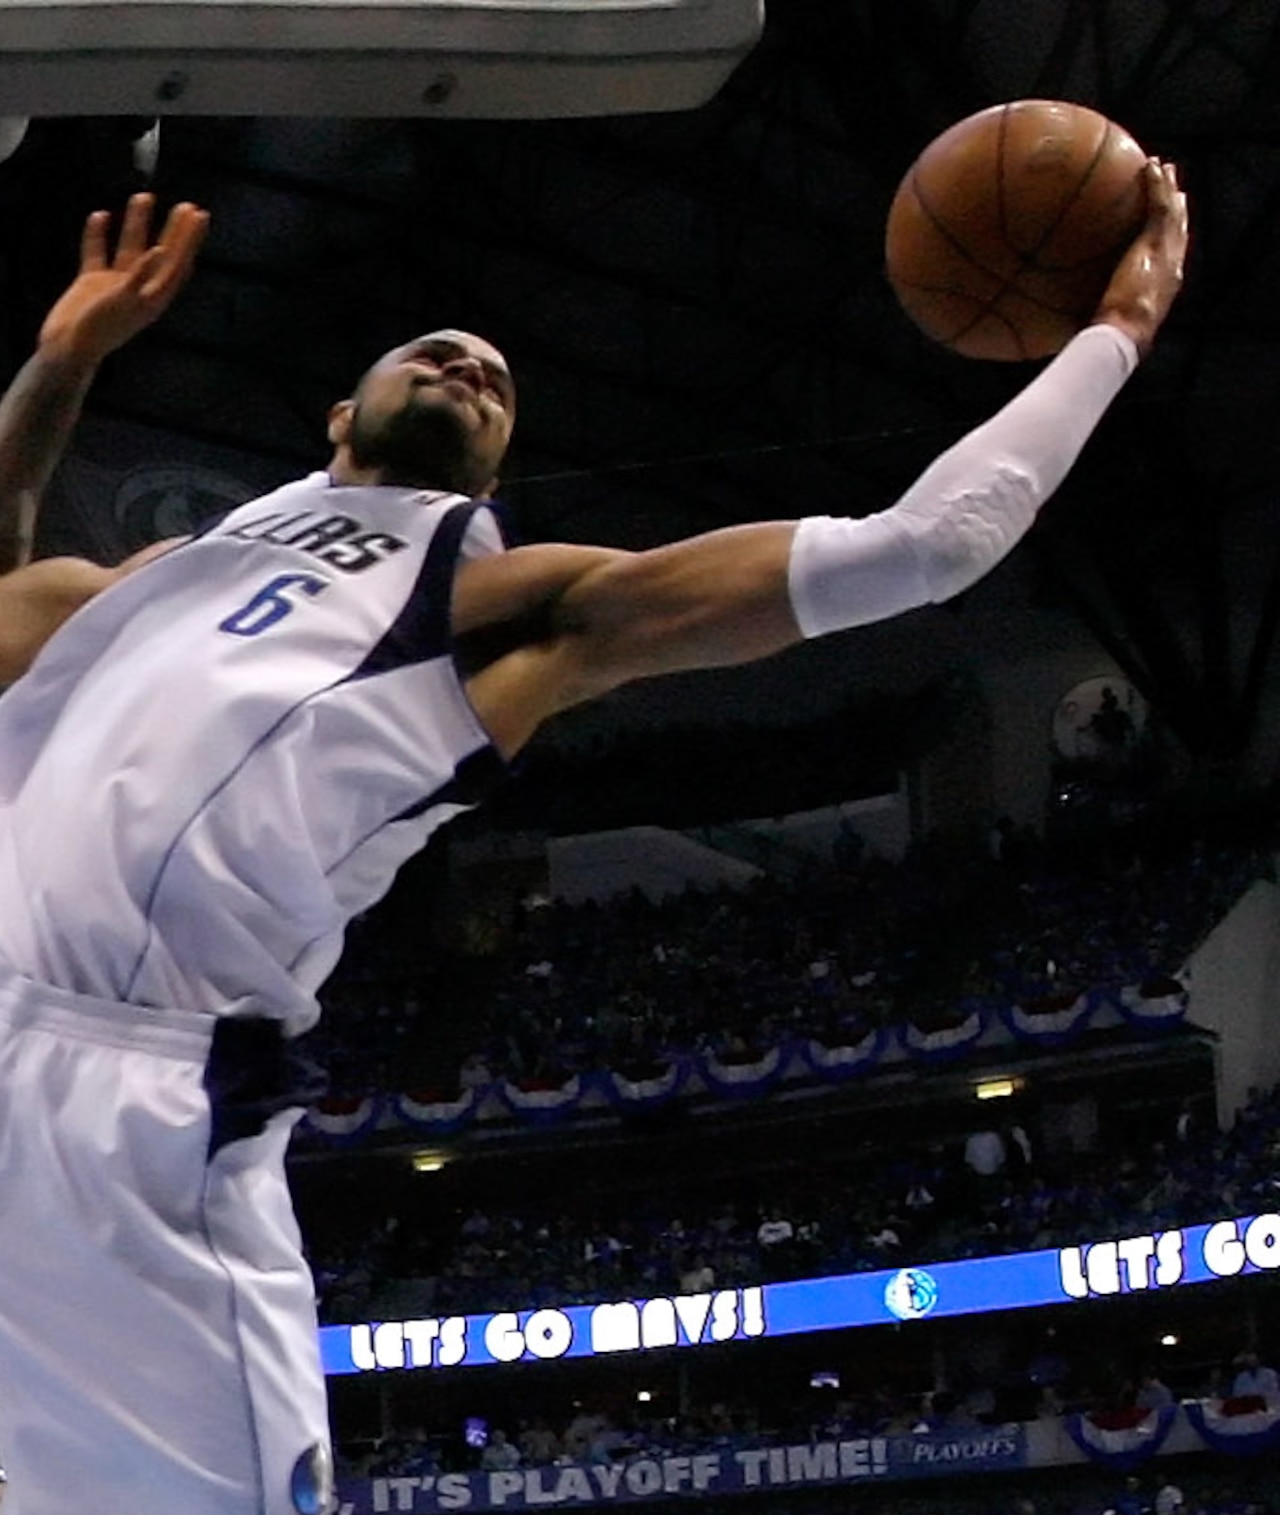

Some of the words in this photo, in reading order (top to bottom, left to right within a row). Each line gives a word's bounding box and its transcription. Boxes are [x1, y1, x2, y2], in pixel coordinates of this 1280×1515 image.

[224, 510, 410, 574] LLAS
[219, 573, 328, 637] 6
[1059, 1230, 1183, 1299] LETS
[1202, 1213, 1280, 1277] GO
[350, 1316, 467, 1371] LETS
[484, 1308, 575, 1362] GO
[590, 1286, 765, 1354] MAVS!
[373, 1473, 472, 1513] IT'S
[489, 1455, 720, 1507] PLAYOFF
[734, 1438, 888, 1486] TIME!
